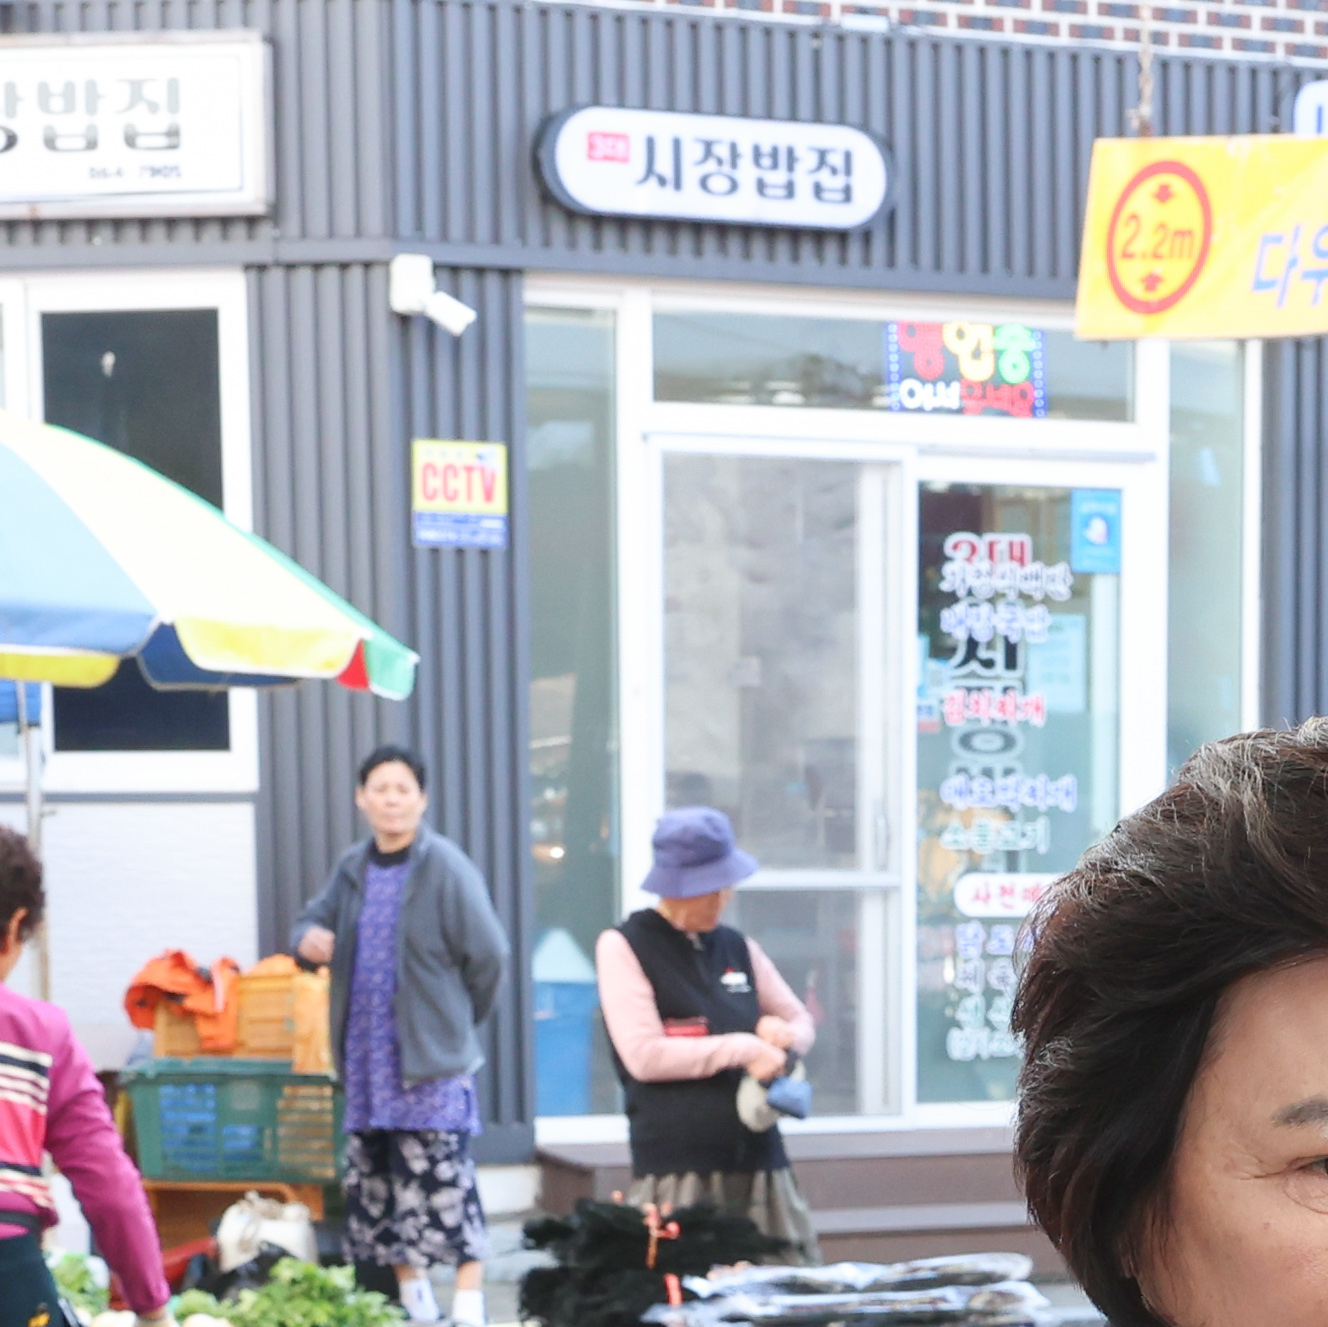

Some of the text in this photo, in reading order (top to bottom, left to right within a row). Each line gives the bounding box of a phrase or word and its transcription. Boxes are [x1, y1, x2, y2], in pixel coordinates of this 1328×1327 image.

[0, 78, 181, 153] 밥집
[635, 134, 854, 204] 시장밥집
[1120, 211, 1197, 263] 2.2m
[421, 462, 497, 503] CCTV
